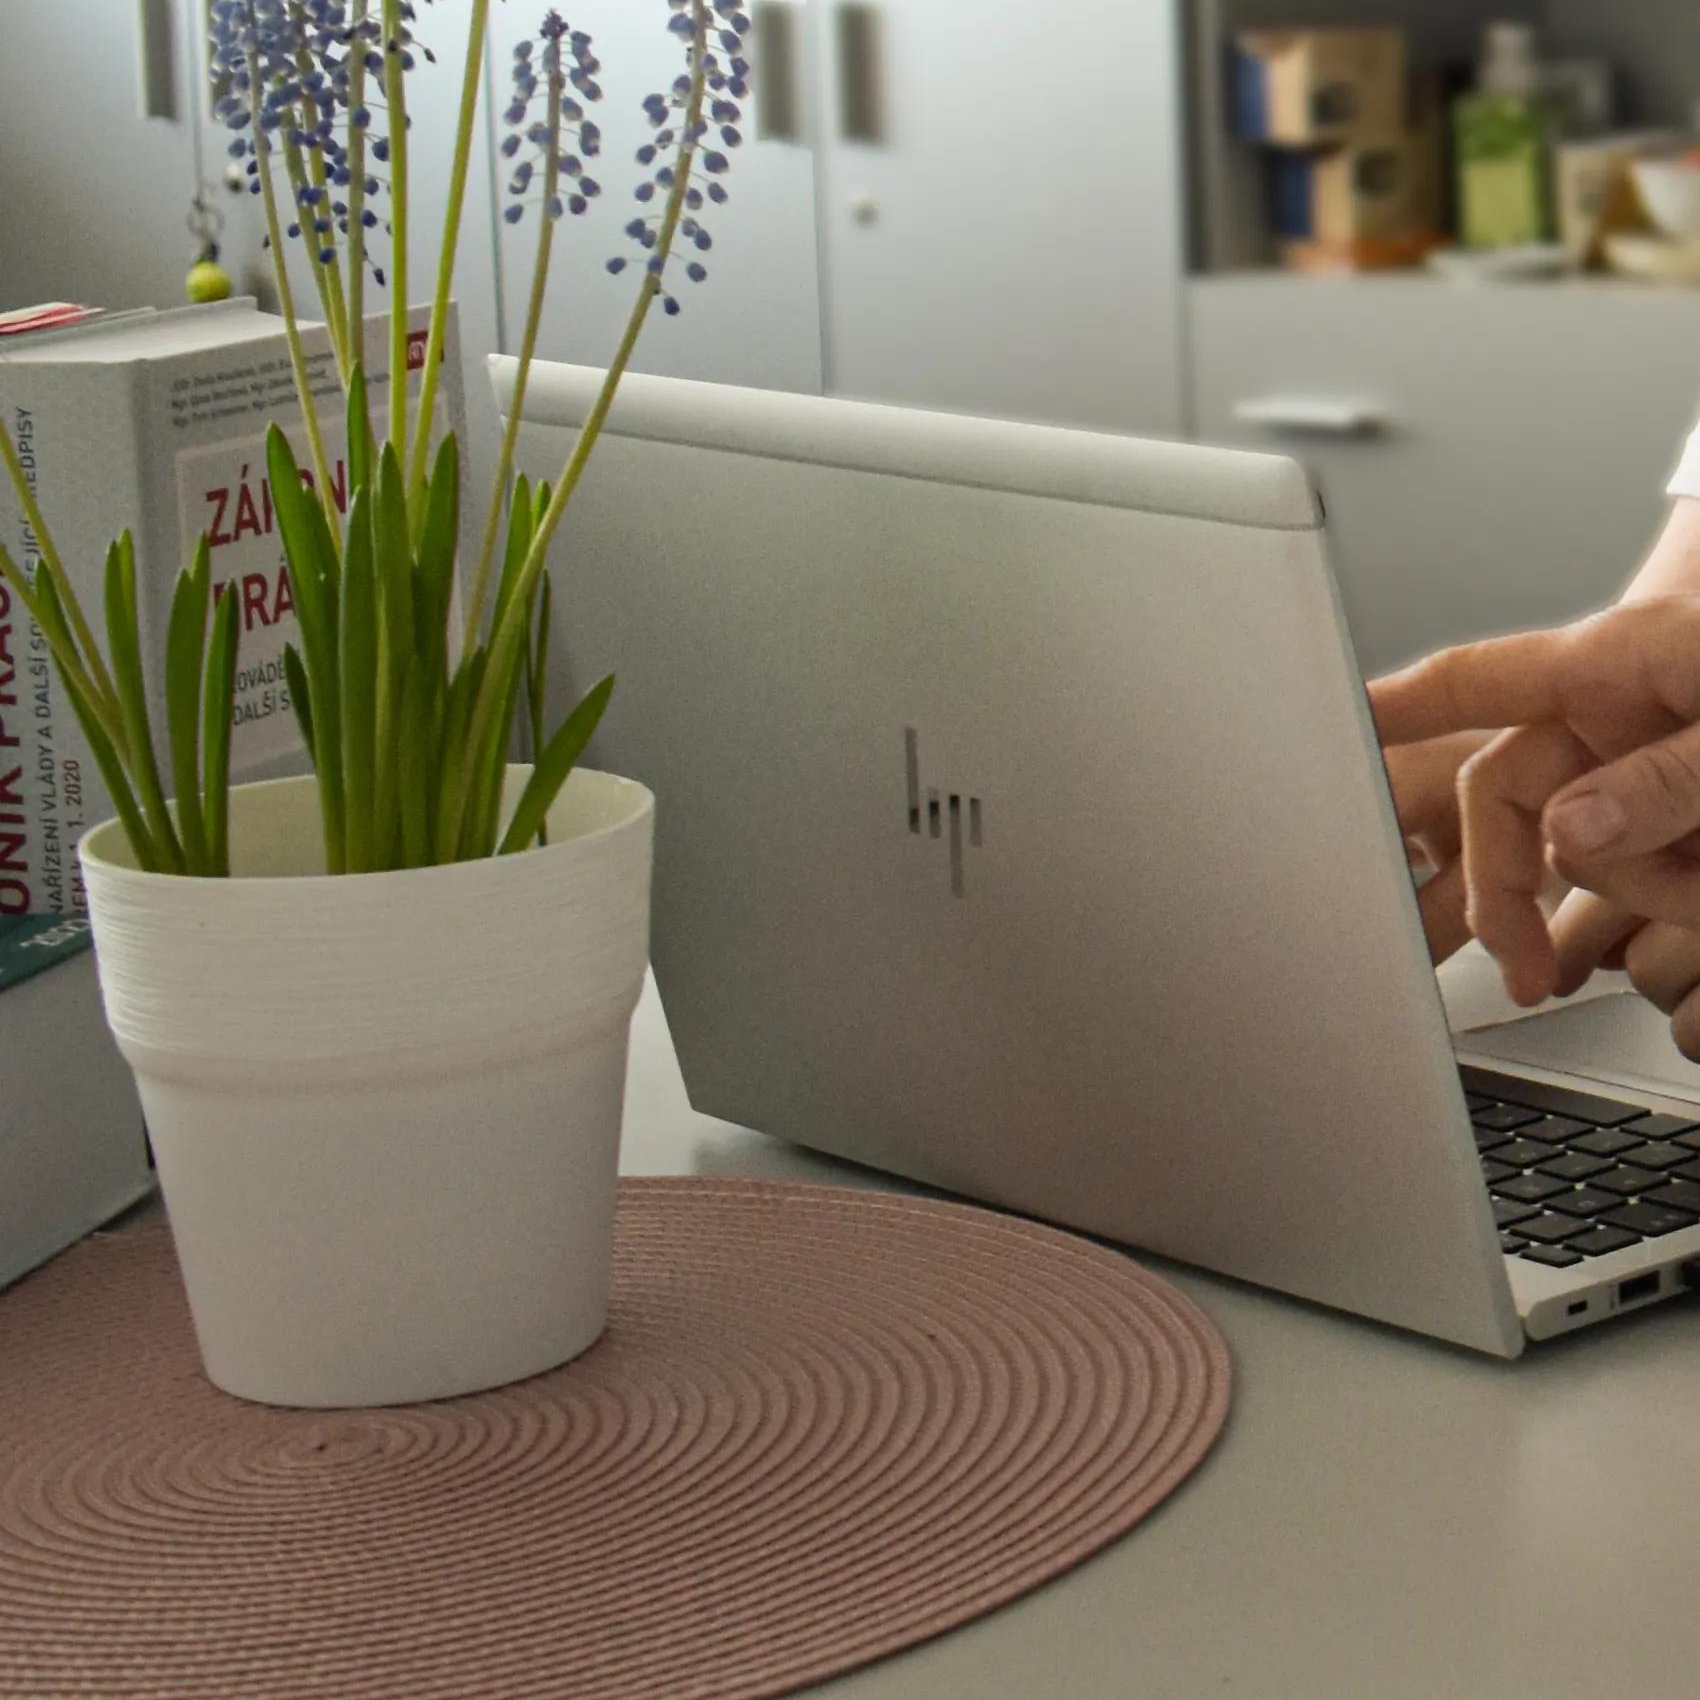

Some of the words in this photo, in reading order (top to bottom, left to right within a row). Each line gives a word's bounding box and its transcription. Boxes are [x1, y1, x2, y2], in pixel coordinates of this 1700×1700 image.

[29, 655, 51, 719] DALŠÍ
[37, 725, 53, 742] A
[37, 745, 58, 812] VLÁDY
[62, 759, 83, 807] 2020
